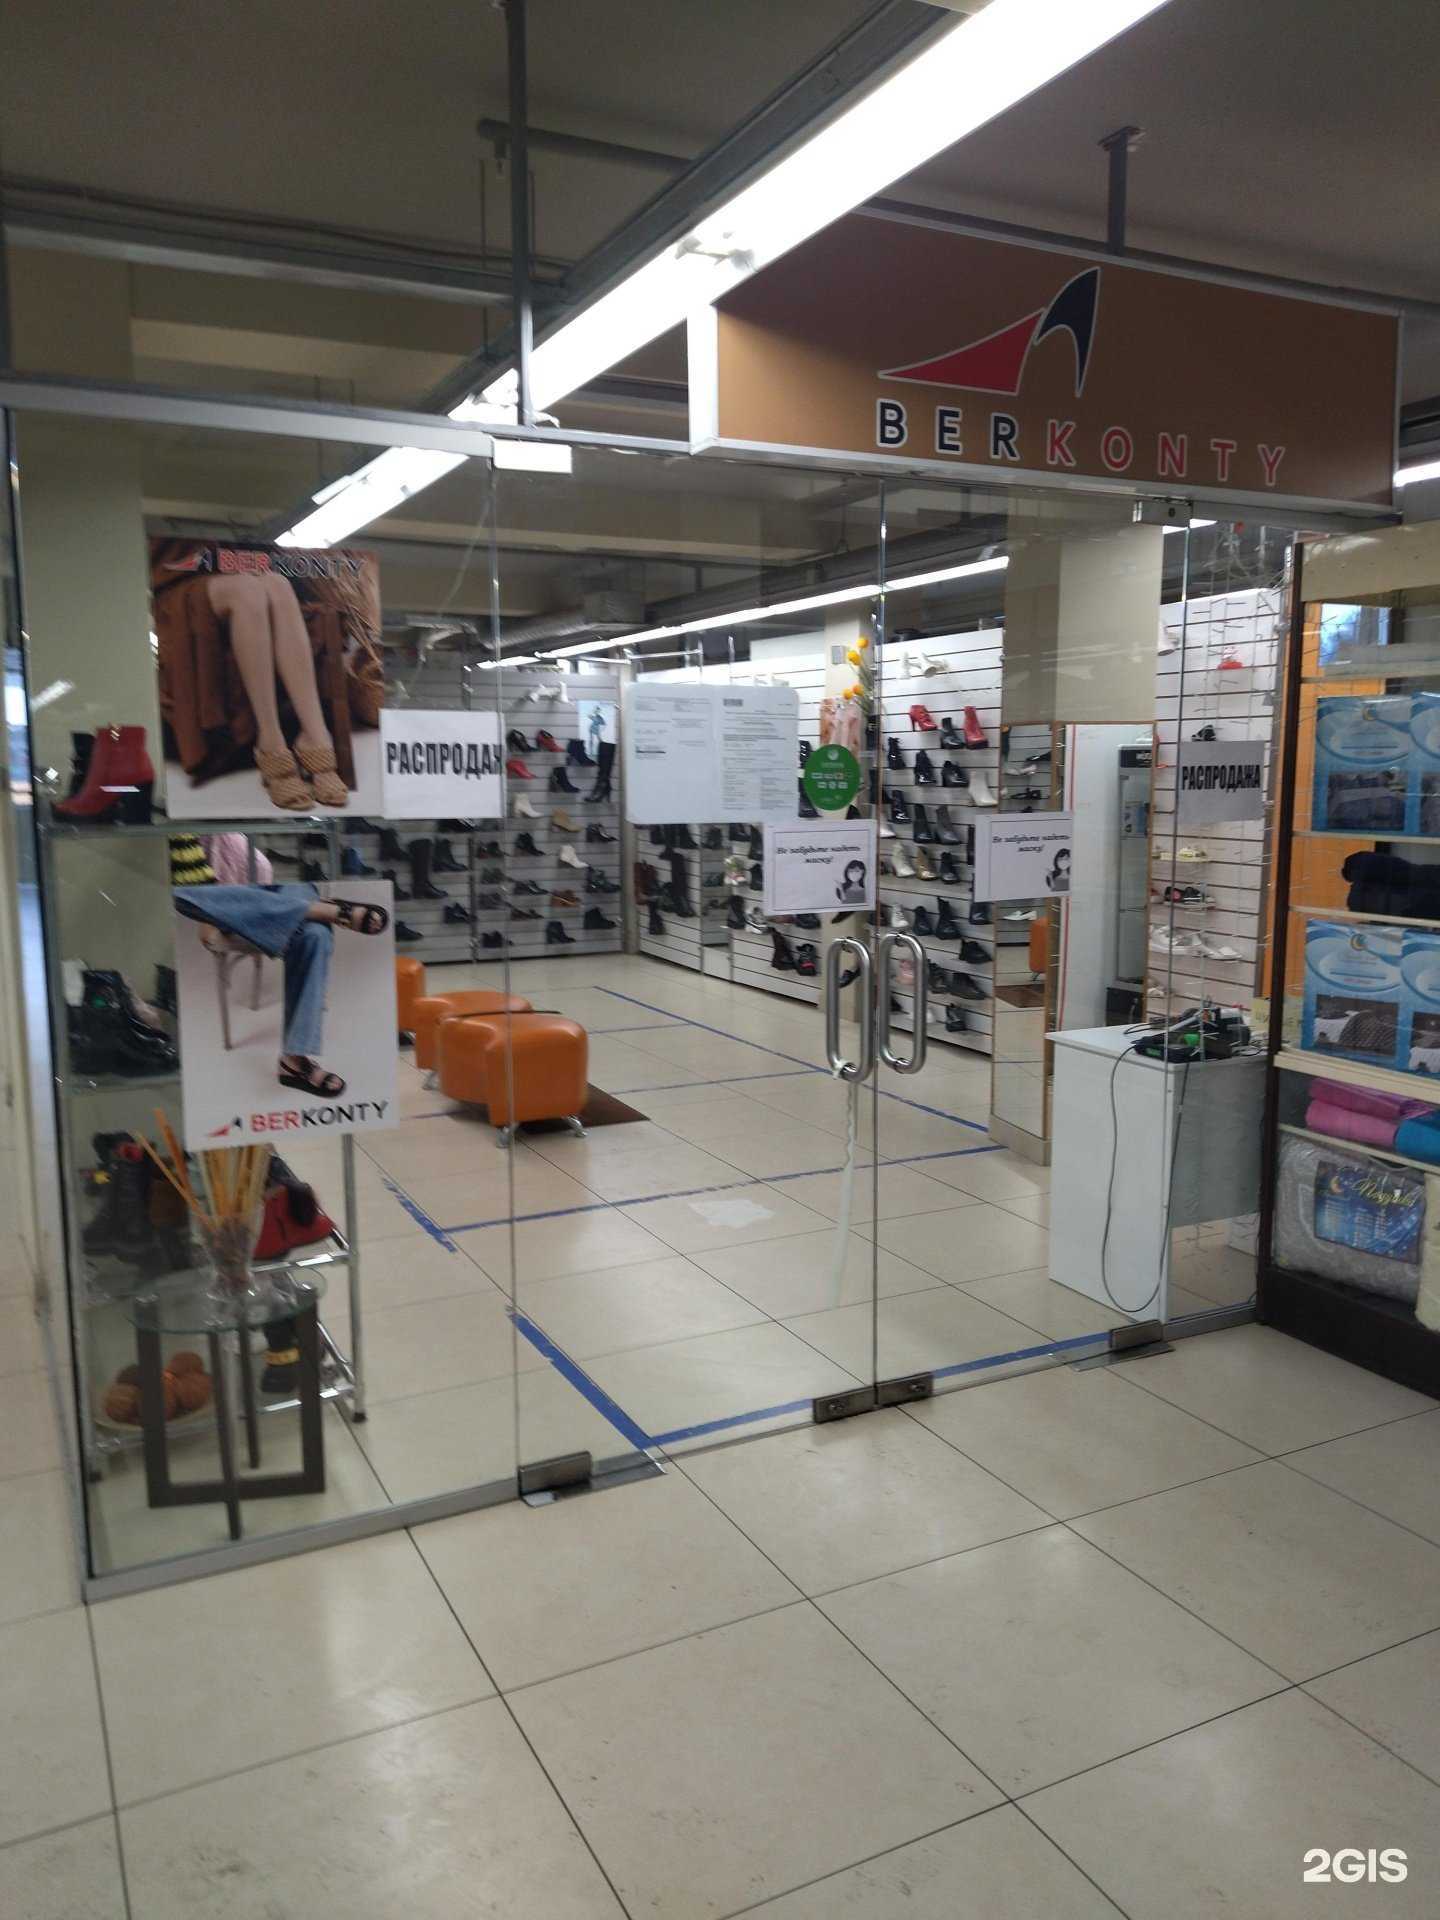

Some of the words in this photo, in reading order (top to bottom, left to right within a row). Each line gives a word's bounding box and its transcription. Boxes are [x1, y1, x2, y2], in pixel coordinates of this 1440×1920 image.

[875, 398, 1287, 487] BERKONTY
[217, 550, 367, 579] BERKONTY
[1181, 764, 1262, 793] РАСПРОДАЖА
[251, 1100, 389, 1132] BERKONTY
